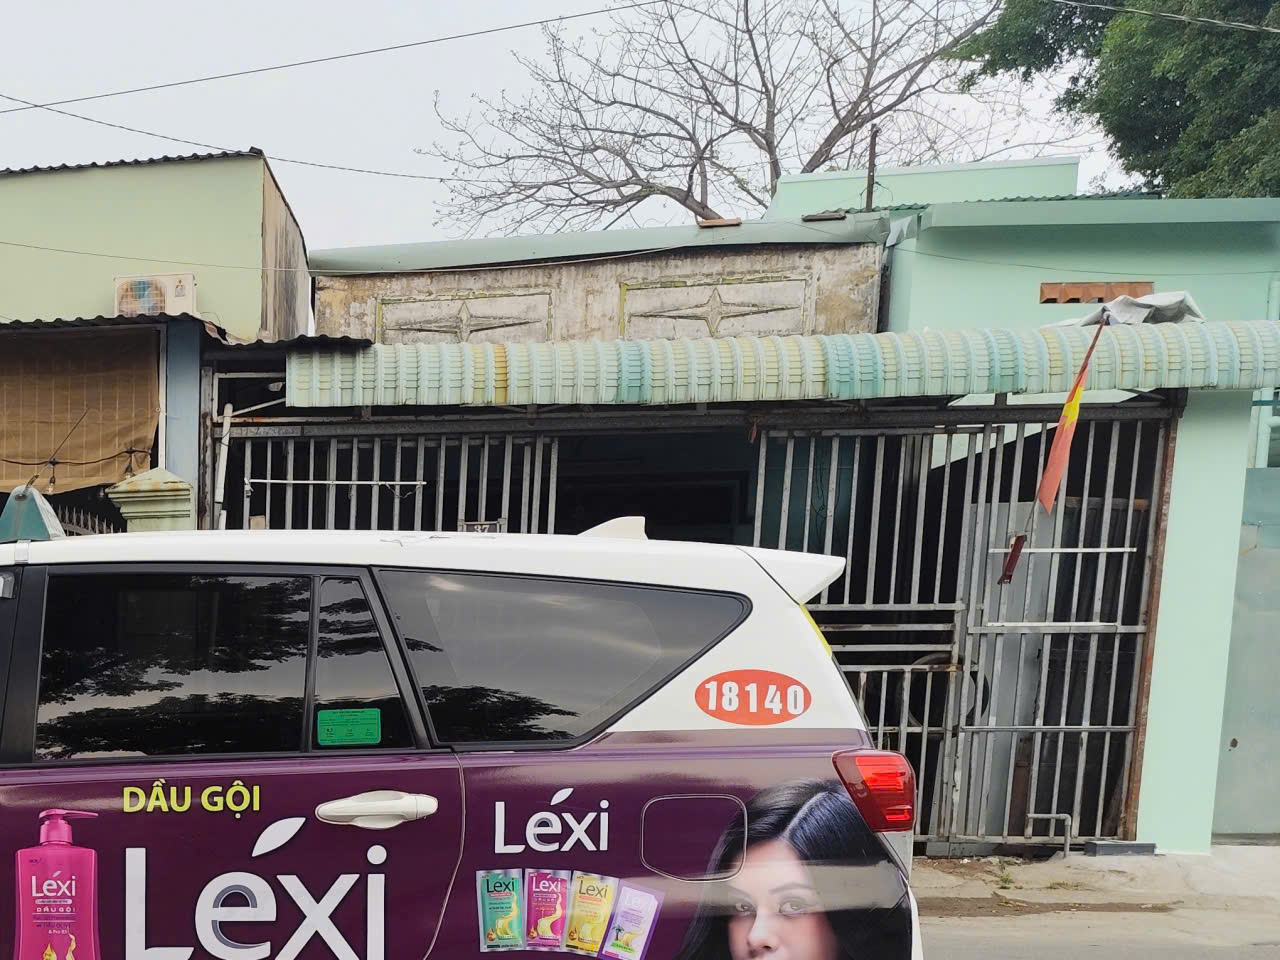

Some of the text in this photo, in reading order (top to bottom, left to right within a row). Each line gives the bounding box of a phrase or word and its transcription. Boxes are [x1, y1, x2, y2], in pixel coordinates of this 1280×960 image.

[704, 680, 806, 716] 18140
[122, 777, 261, 819] DẦU GỘI
